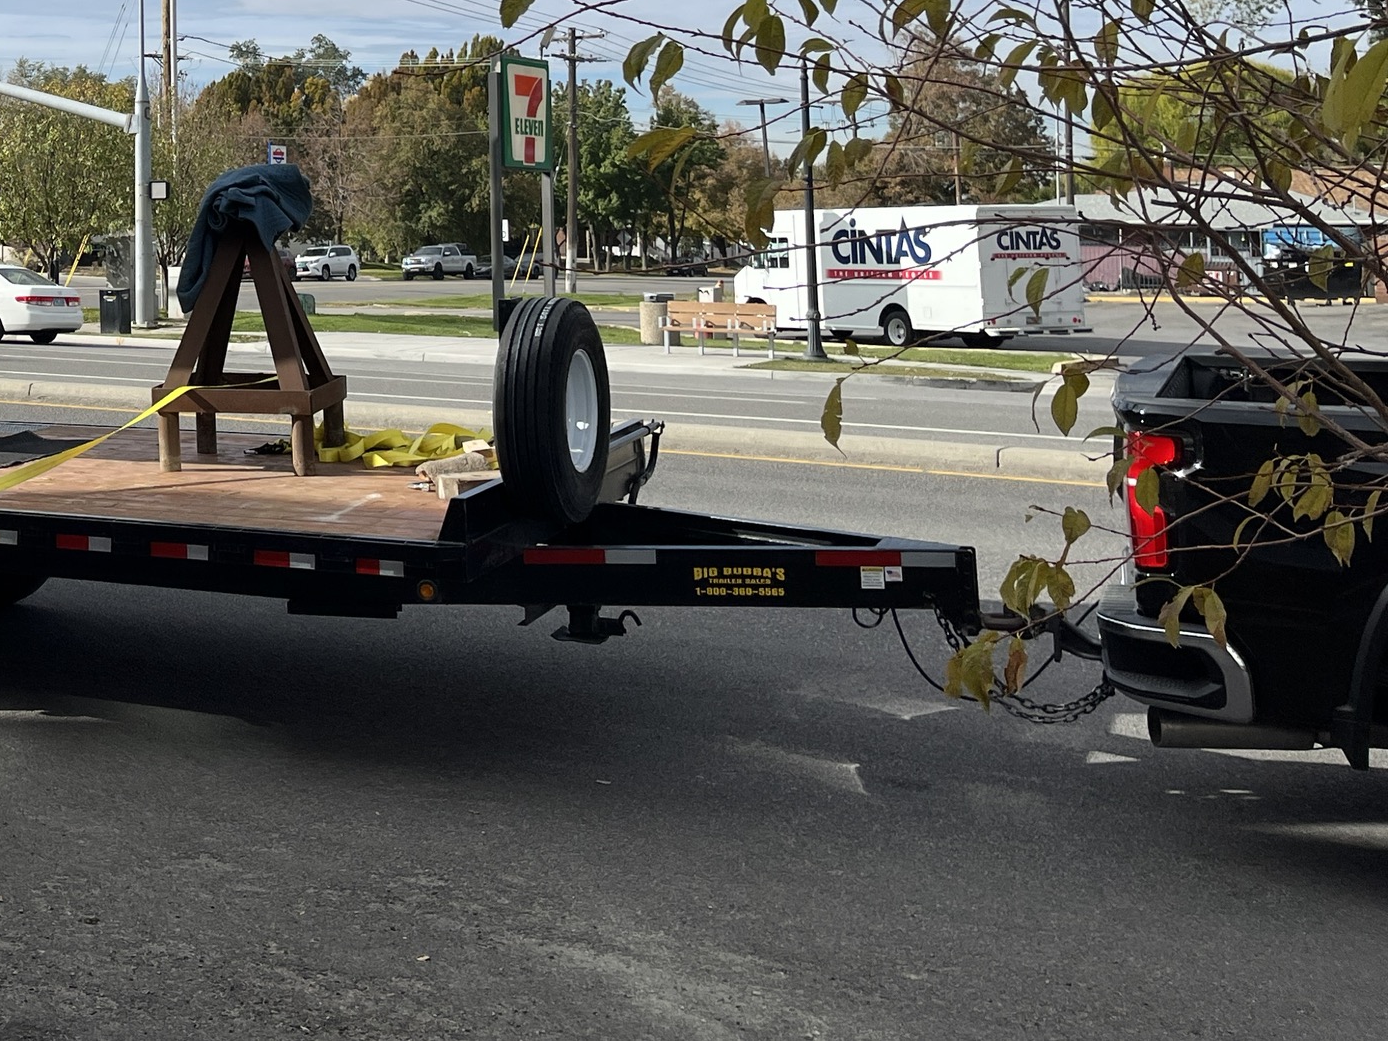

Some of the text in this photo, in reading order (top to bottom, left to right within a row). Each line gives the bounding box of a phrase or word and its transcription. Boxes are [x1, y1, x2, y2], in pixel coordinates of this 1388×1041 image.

[514, 73, 543, 164] 7
[833, 270, 849, 278] THE
[693, 567, 718, 581] BIG
